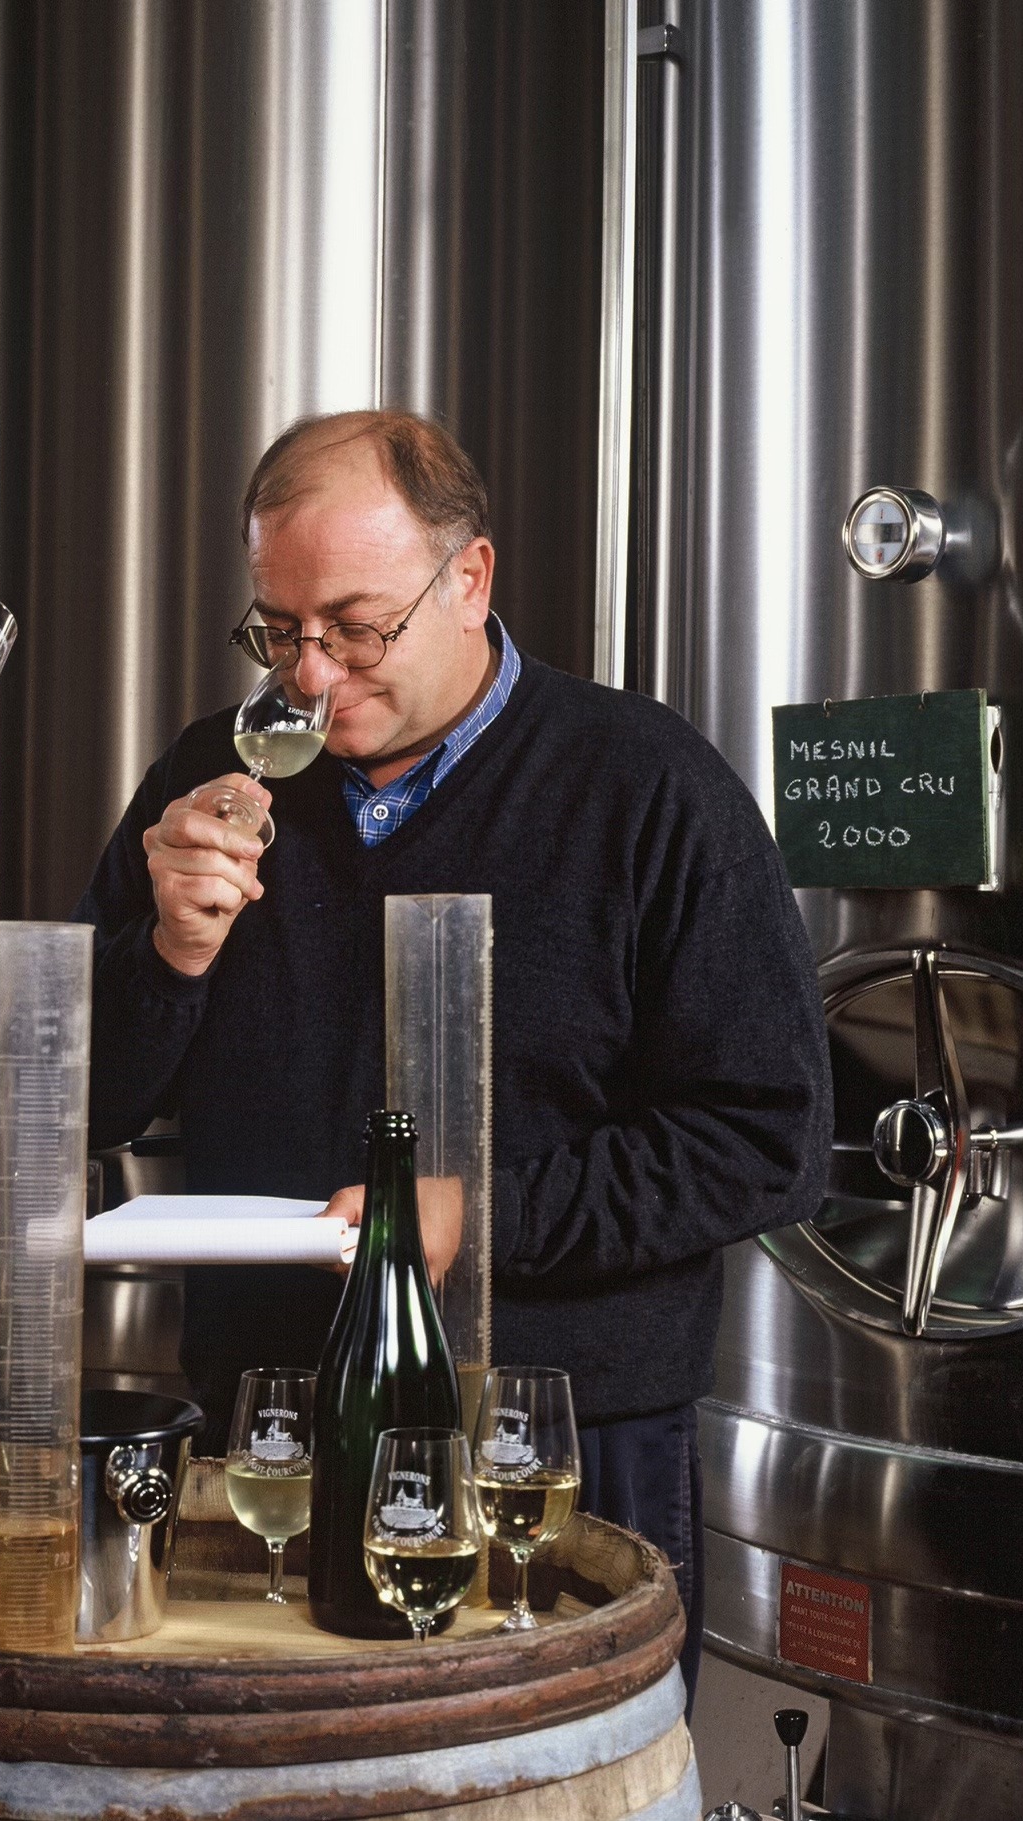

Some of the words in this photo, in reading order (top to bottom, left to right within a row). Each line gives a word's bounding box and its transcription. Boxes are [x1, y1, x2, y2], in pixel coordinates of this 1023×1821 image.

[790, 739, 895, 761] MESNIL
[785, 775, 881, 802] GRAND
[900, 773, 955, 795] CRU
[818, 821, 911, 848] 2000
[258, 1408, 298, 1420] VIGNERONS
[490, 1407, 529, 1422] VIGNERONS
[388, 1471, 431, 1486] VIGNERONS
